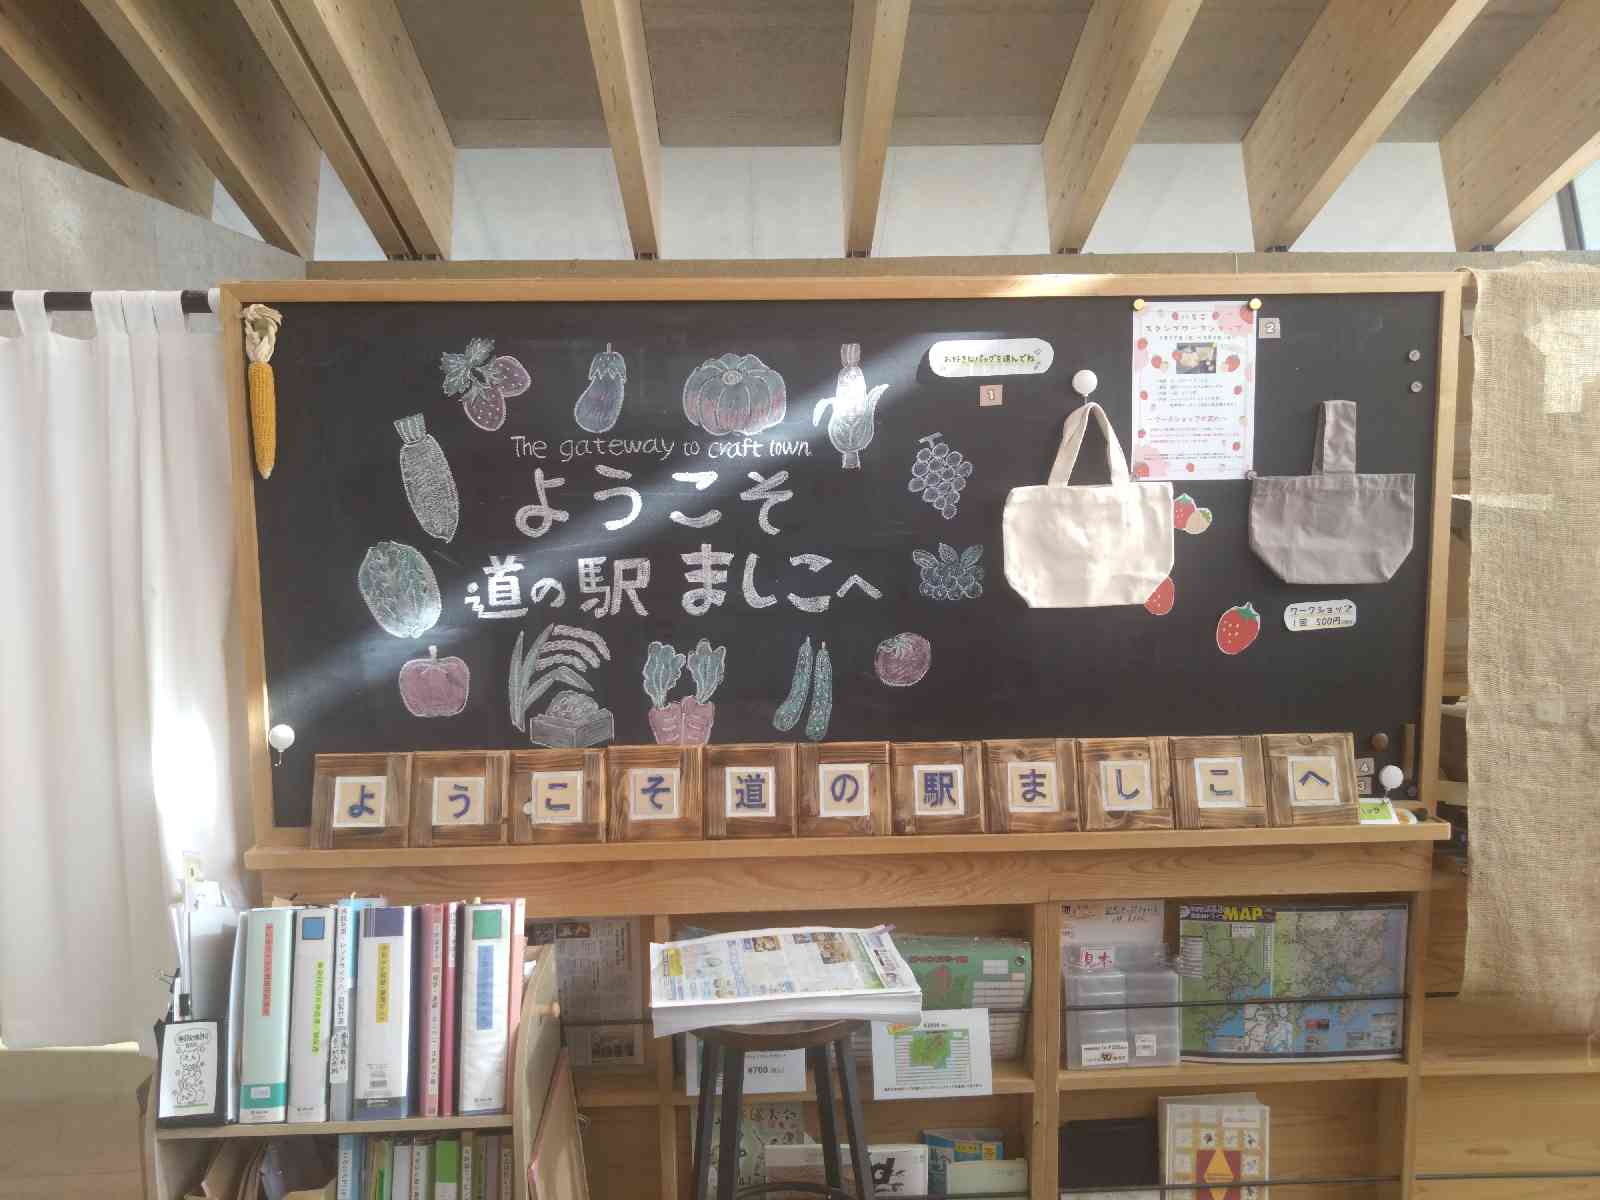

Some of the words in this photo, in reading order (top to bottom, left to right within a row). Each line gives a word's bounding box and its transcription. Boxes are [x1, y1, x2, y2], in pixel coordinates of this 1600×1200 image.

[510, 435, 548, 459] The
[559, 437, 676, 462] gateway
[683, 439, 701, 457] to
[708, 438, 762, 458] craft
[769, 439, 812, 457] town
[515, 464, 794, 538] ようこそ
[1224, 905, 1264, 921] MAP
